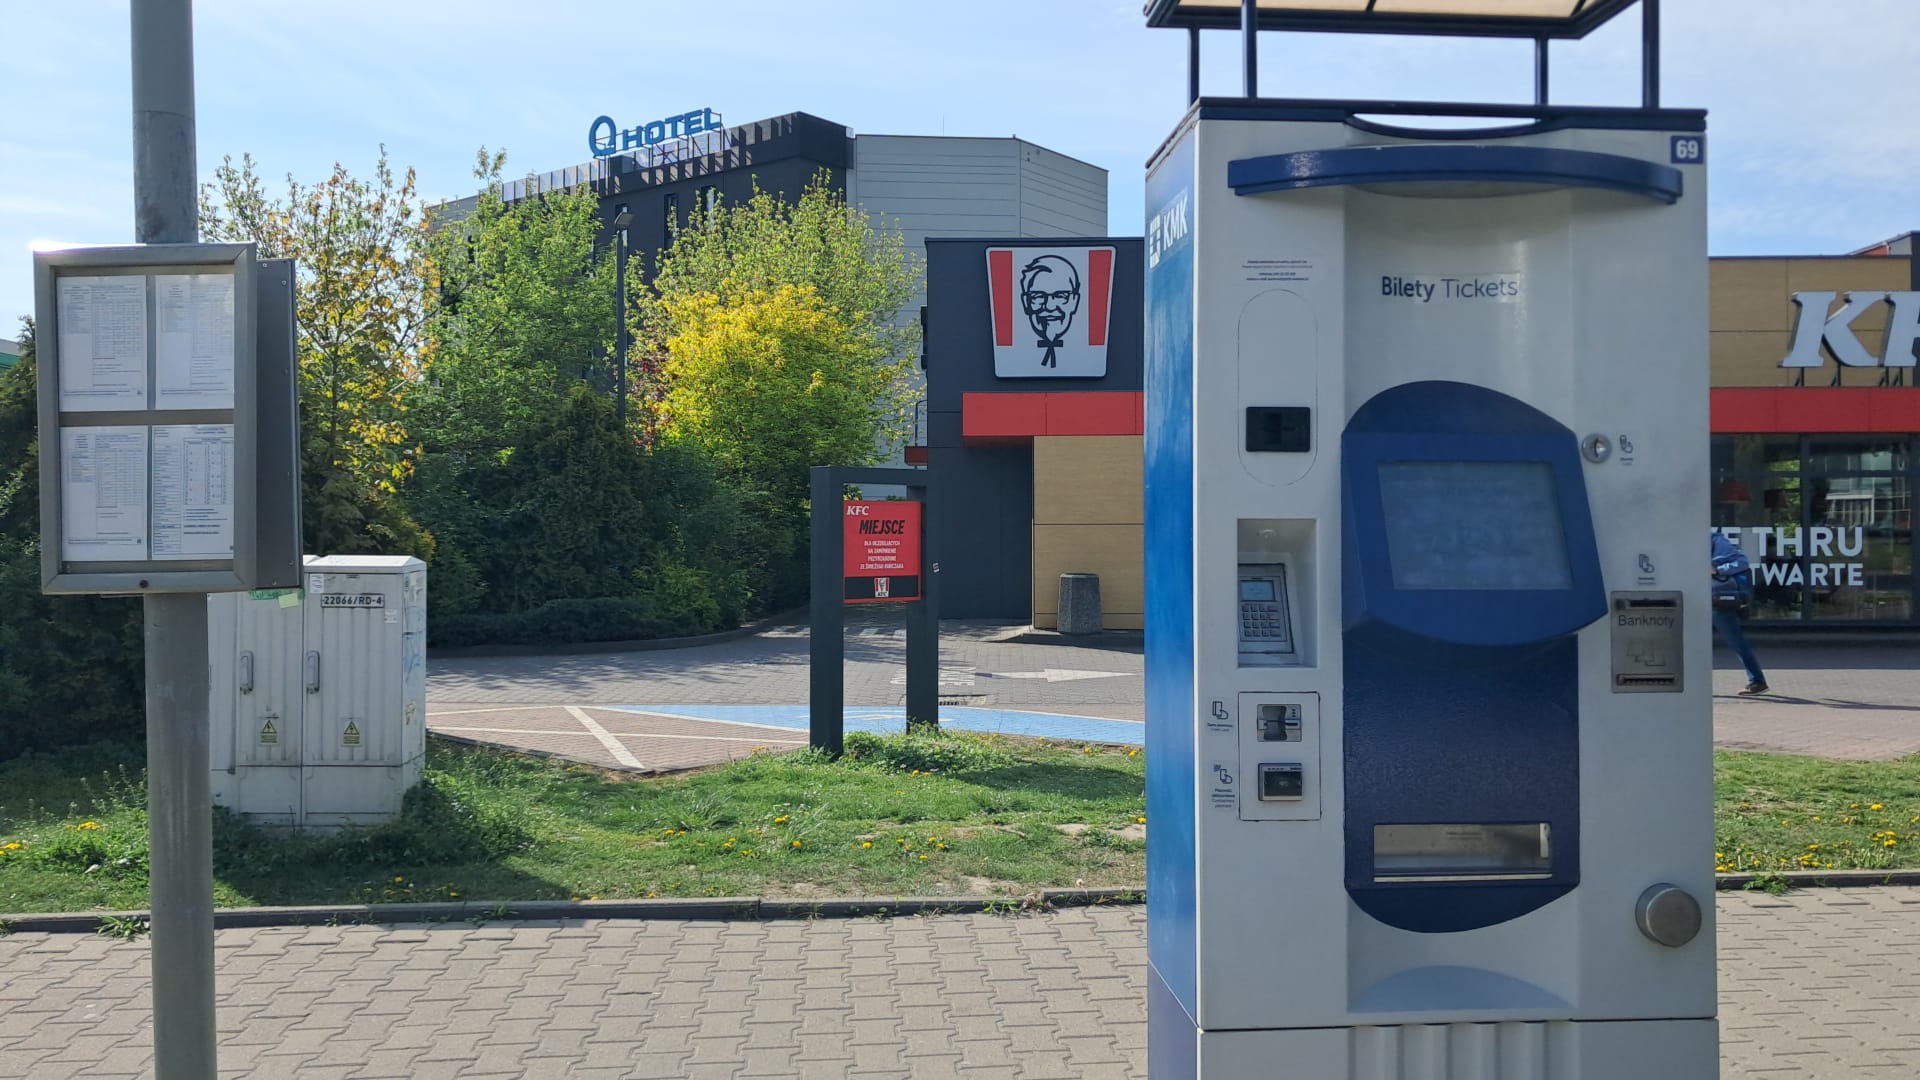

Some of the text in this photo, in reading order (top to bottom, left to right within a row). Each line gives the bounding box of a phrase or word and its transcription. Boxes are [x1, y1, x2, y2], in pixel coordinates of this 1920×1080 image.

[588, 107, 721, 157] Q HOTEL
[1676, 140, 1699, 159] 69
[1163, 194, 1188, 251] KMK
[1381, 276, 1518, 303] Bilety Tickets
[846, 505, 870, 516] KFC
[859, 519, 905, 535] MIEJSCE
[1752, 526, 1863, 557] THRU
[323, 595, 382, 605] 22066/RD-4
[1618, 614, 1674, 629] Banknoty
